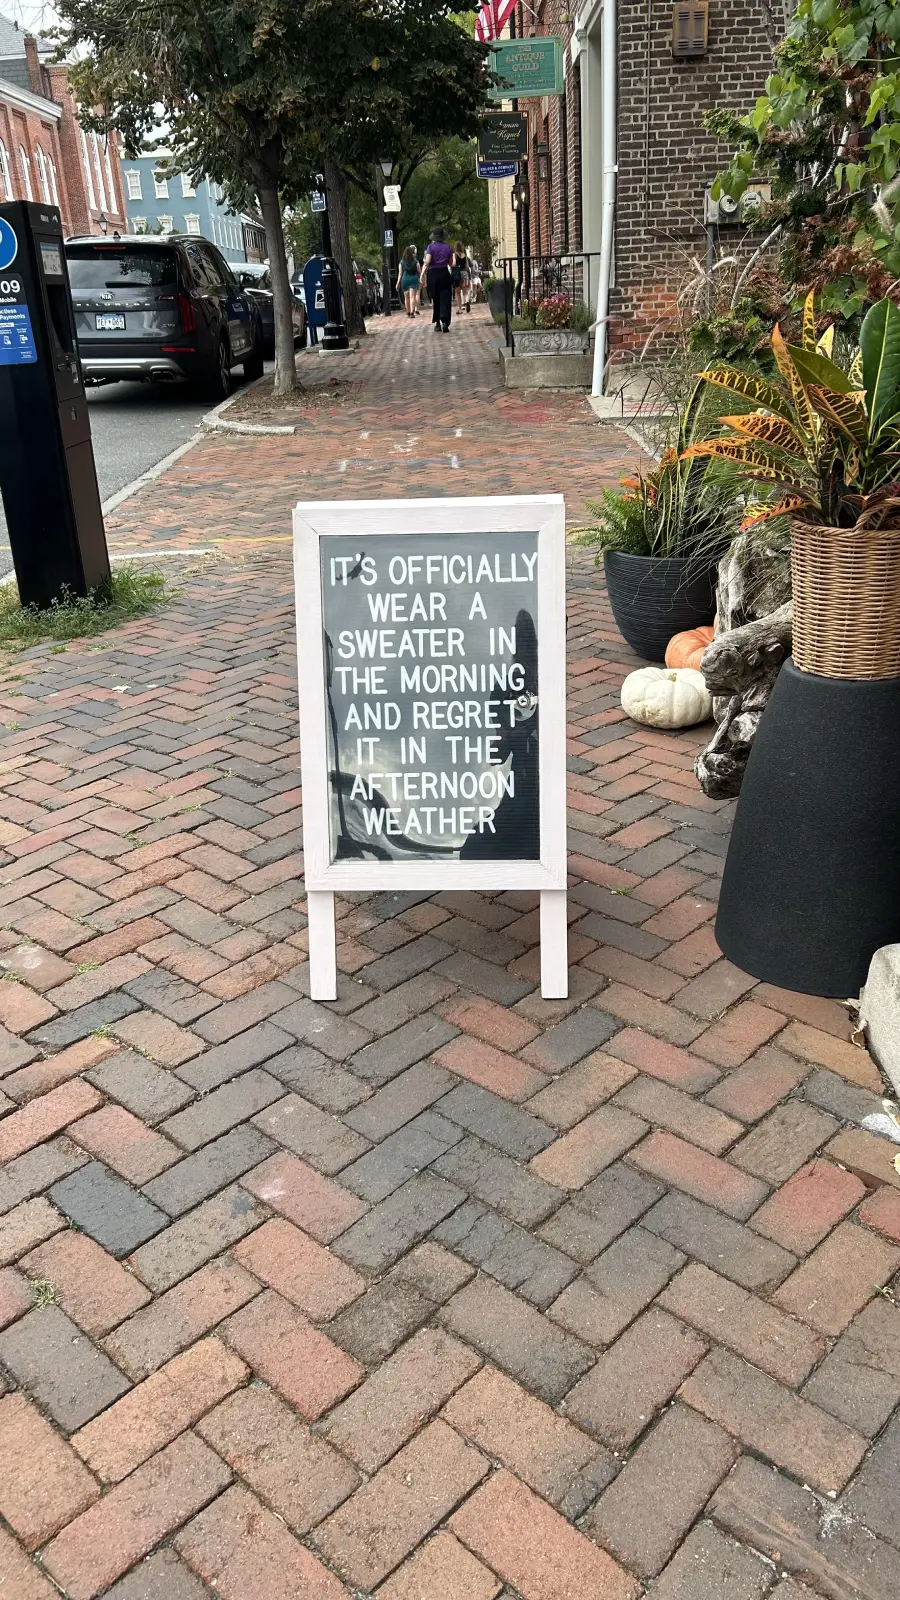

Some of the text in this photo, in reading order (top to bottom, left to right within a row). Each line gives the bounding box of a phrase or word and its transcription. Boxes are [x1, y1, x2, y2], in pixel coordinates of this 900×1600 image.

[505, 52, 545, 63] ANTIQUE
[512, 63, 539, 71] GUILD
[0, 280, 20, 293] 09
[330, 552, 538, 586] IT'S OFFICIALLY
[367, 591, 488, 622] WEAR A
[337, 626, 516, 659] SWEATER IN
[334, 663, 526, 695] THE MORNING
[344, 700, 519, 731] AND REGRET
[356, 735, 503, 765] IT IN THE
[350, 771, 515, 801] AFTERNOON
[362, 806, 497, 836] WEATHER
